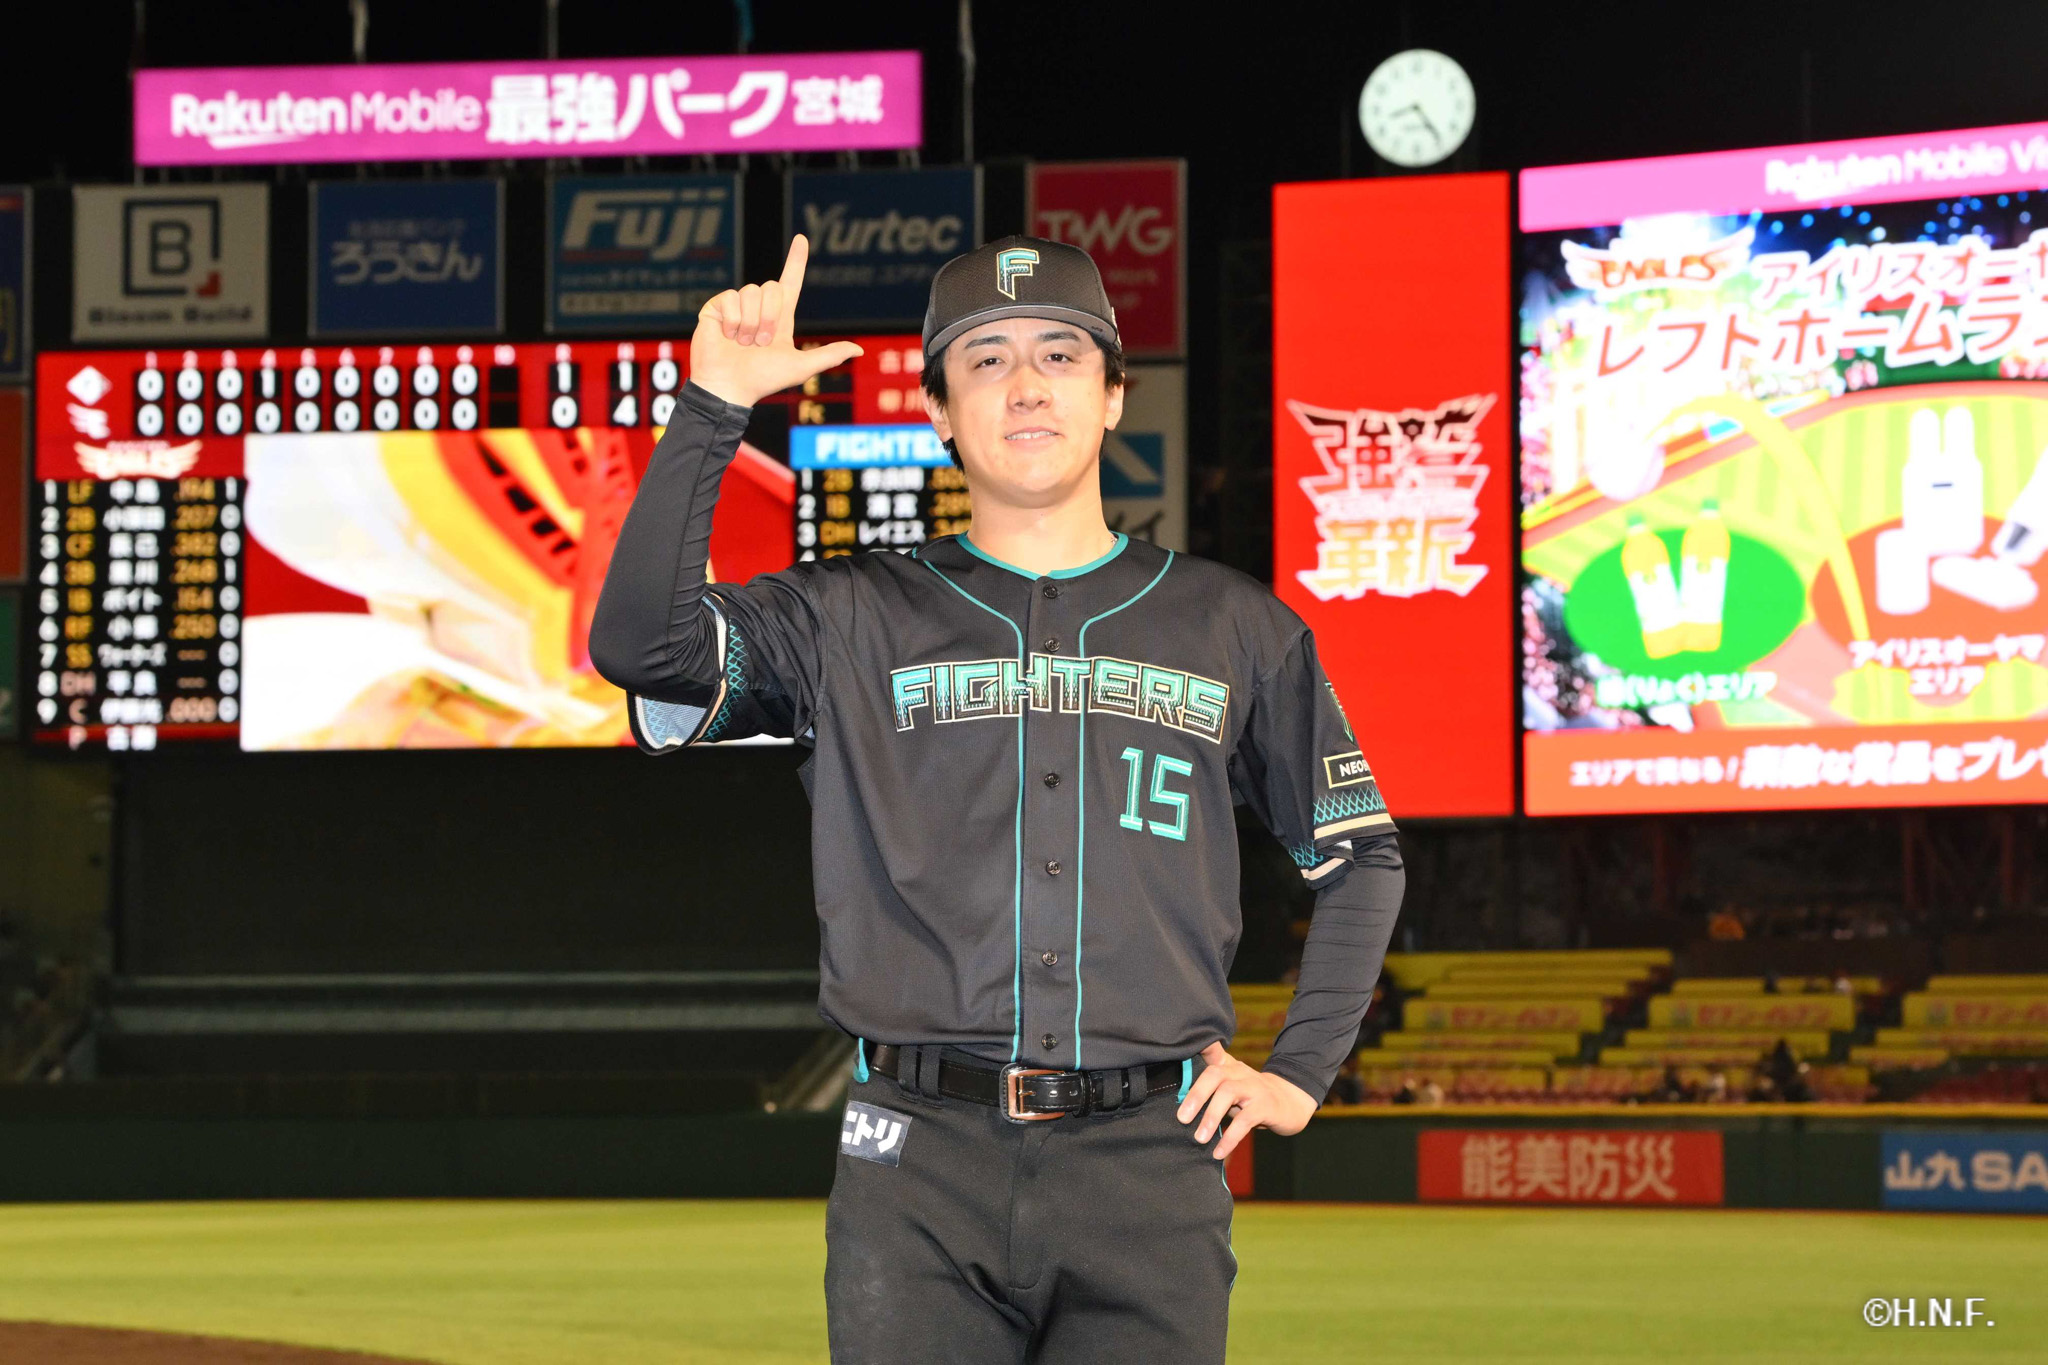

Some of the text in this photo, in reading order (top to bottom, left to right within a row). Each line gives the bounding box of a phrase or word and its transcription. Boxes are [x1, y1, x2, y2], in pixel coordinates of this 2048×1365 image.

[170, 88, 482, 142] Rakuten Mobile
[1764, 154, 1903, 200] Rakuten
[1904, 142, 2010, 184] Mobile
[561, 186, 727, 263] Fuji
[804, 203, 963, 256] Yurtec
[149, 220, 191, 277] B
[330, 238, 484, 285] ろうきん
[996, 247, 1040, 301] F
[145, 351, 157, 368] 1
[137, 360, 678, 400] 0 0 0 1 0 0 0 0 0 1 1 0
[137, 402, 163, 436] 0
[177, 402, 203, 435] 0
[216, 402, 242, 435] 0
[255, 401, 281, 434] 0
[295, 401, 321, 433] 0
[334, 400, 361, 433] 0
[373, 399, 399, 432] 0
[413, 398, 439, 430] 0
[452, 398, 478, 430] 0
[552, 396, 578, 428] 0
[613, 395, 638, 426] 4
[44, 479, 57, 504] 1
[224, 476, 238, 501] 1
[800, 468, 813, 491] 1
[41, 506, 60, 532] 2
[220, 504, 241, 530] 0
[798, 494, 816, 519] 2
[40, 533, 60, 559] 3
[220, 531, 241, 557] 0
[798, 521, 816, 547] 3
[39, 561, 59, 586] 4
[224, 558, 237, 583] 1
[220, 586, 240, 612] 0
[39, 616, 59, 642] 6
[219, 613, 239, 639] 0
[39, 643, 58, 669] 7
[219, 641, 239, 667] 0
[38, 671, 57, 697] 8
[218, 669, 239, 695] 0
[1909, 665, 1986, 695] エリア
[37, 699, 58, 725] 9
[218, 697, 239, 723] 0
[889, 652, 1231, 744] FIGHTERS
[1119, 746, 1193, 842] 15
[841, 1110, 902, 1154] ニトリ
[1461, 1133, 1679, 1201] 能美防災
